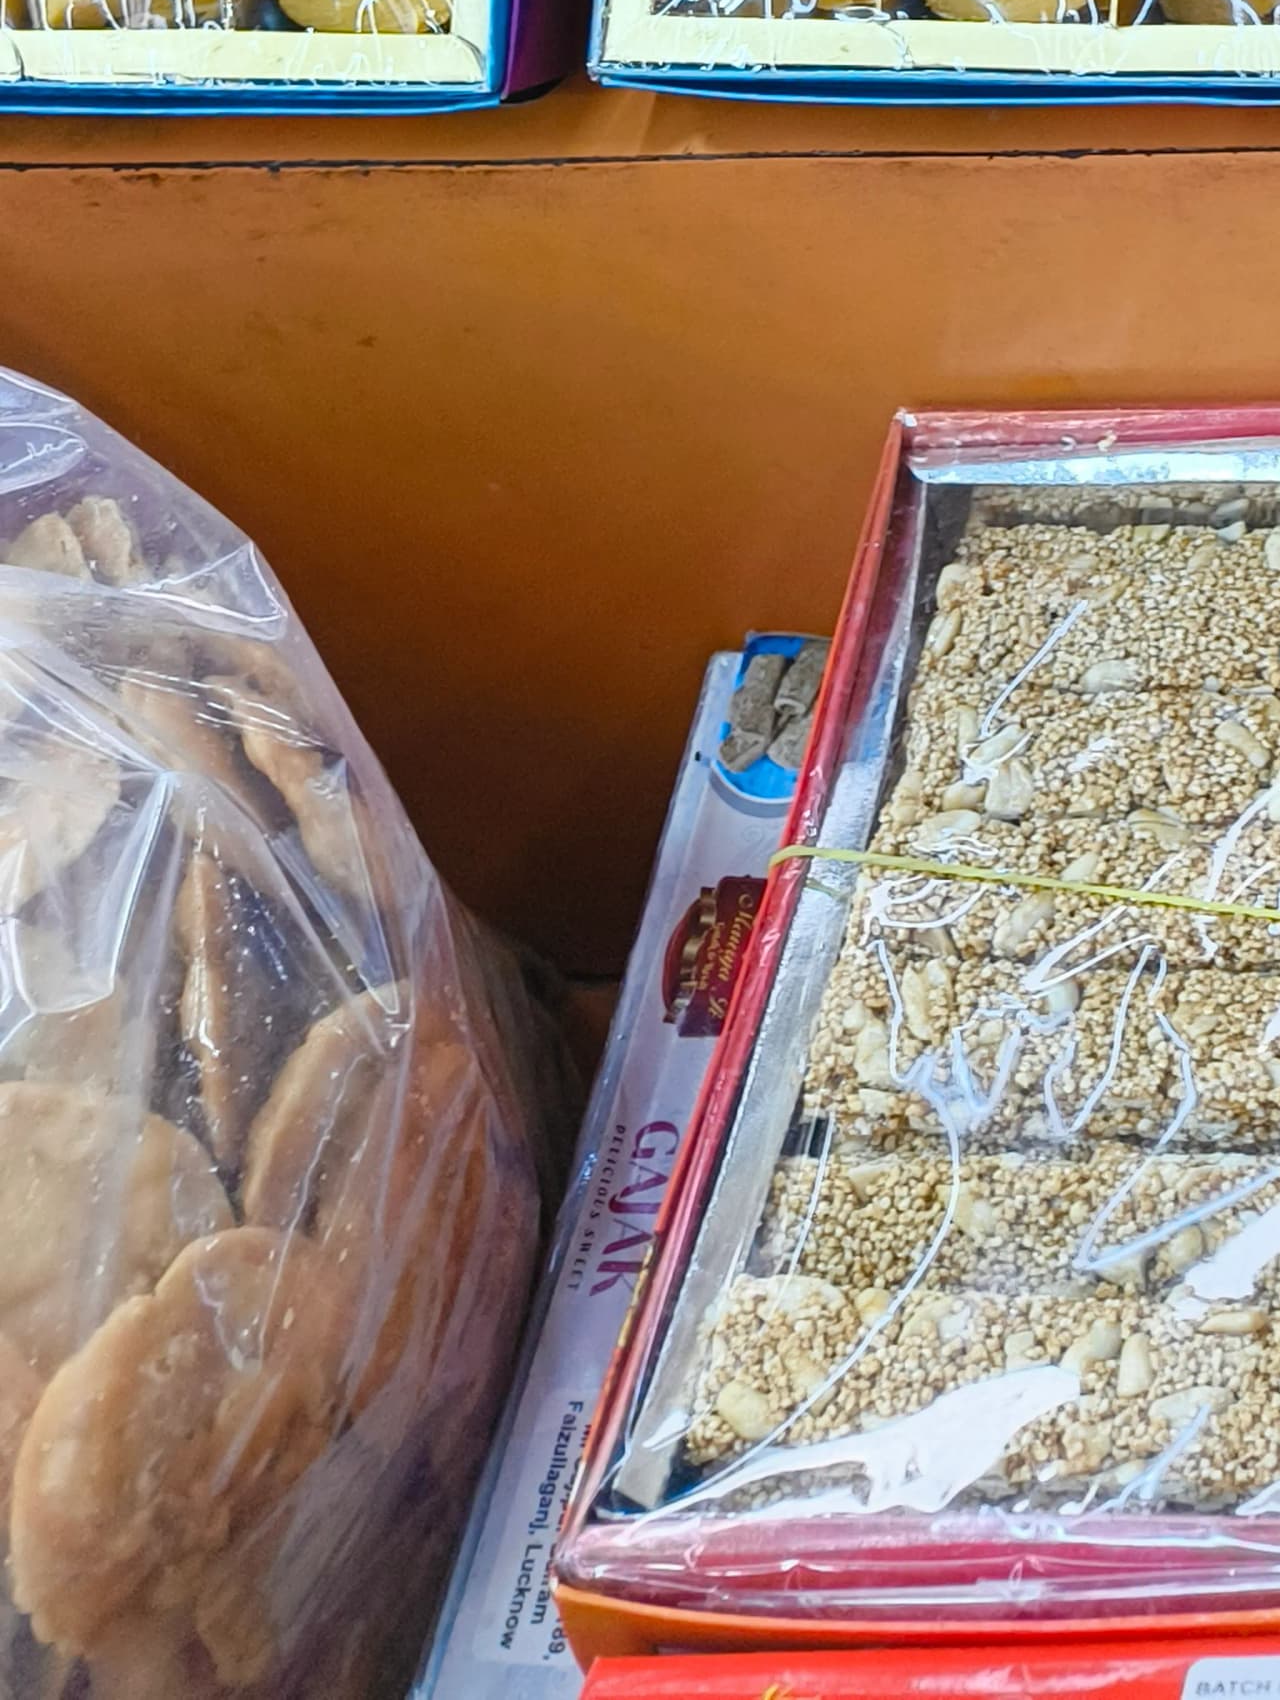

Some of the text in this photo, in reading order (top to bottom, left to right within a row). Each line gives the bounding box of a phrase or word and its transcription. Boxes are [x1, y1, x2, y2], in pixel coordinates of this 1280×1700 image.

[567, 1124, 627, 1291] DELICIOUS SWEET
[589, 1120, 680, 1297] GAJAK
[528, 1400, 584, 1536] Faizullaganj,
[500, 1543, 543, 1650] Lucknow
[1195, 1679, 1272, 1696] BATCH
